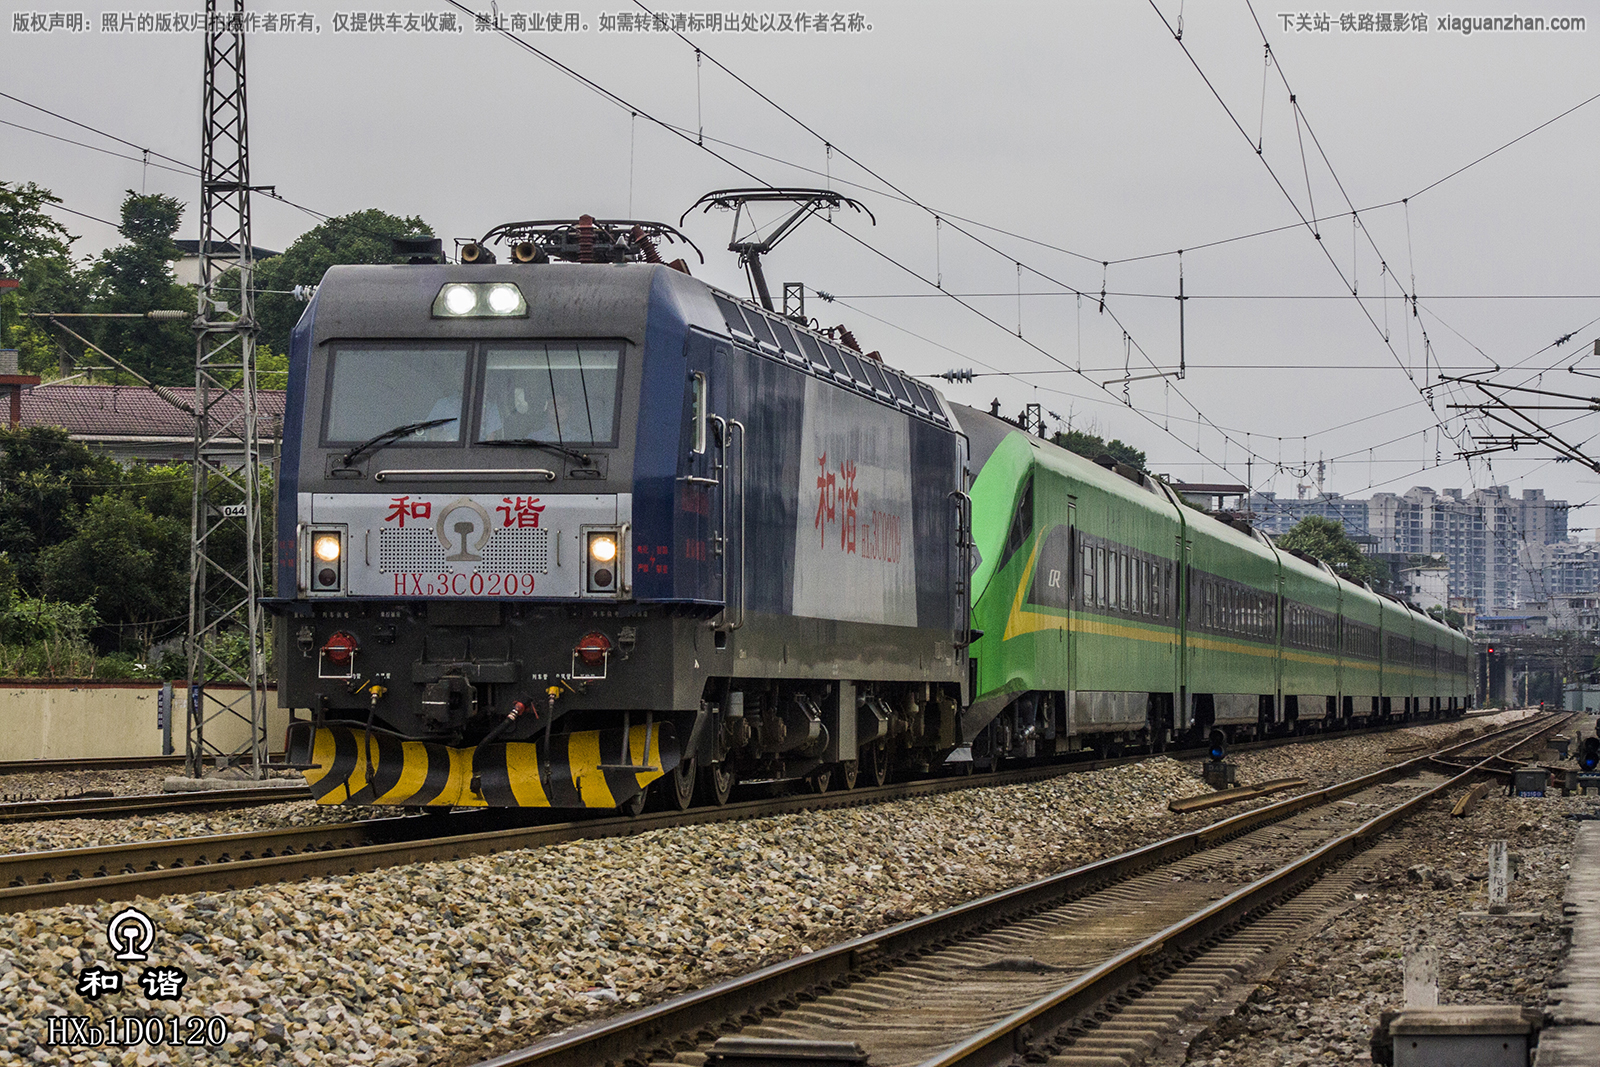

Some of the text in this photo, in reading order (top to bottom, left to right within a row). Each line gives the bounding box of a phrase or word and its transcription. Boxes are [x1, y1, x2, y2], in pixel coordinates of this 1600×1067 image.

[224, 506, 245, 516] 044
[384, 496, 546, 528] 和 谐
[815, 451, 859, 555] 和谐
[393, 573, 535, 596] HXD3C0209
